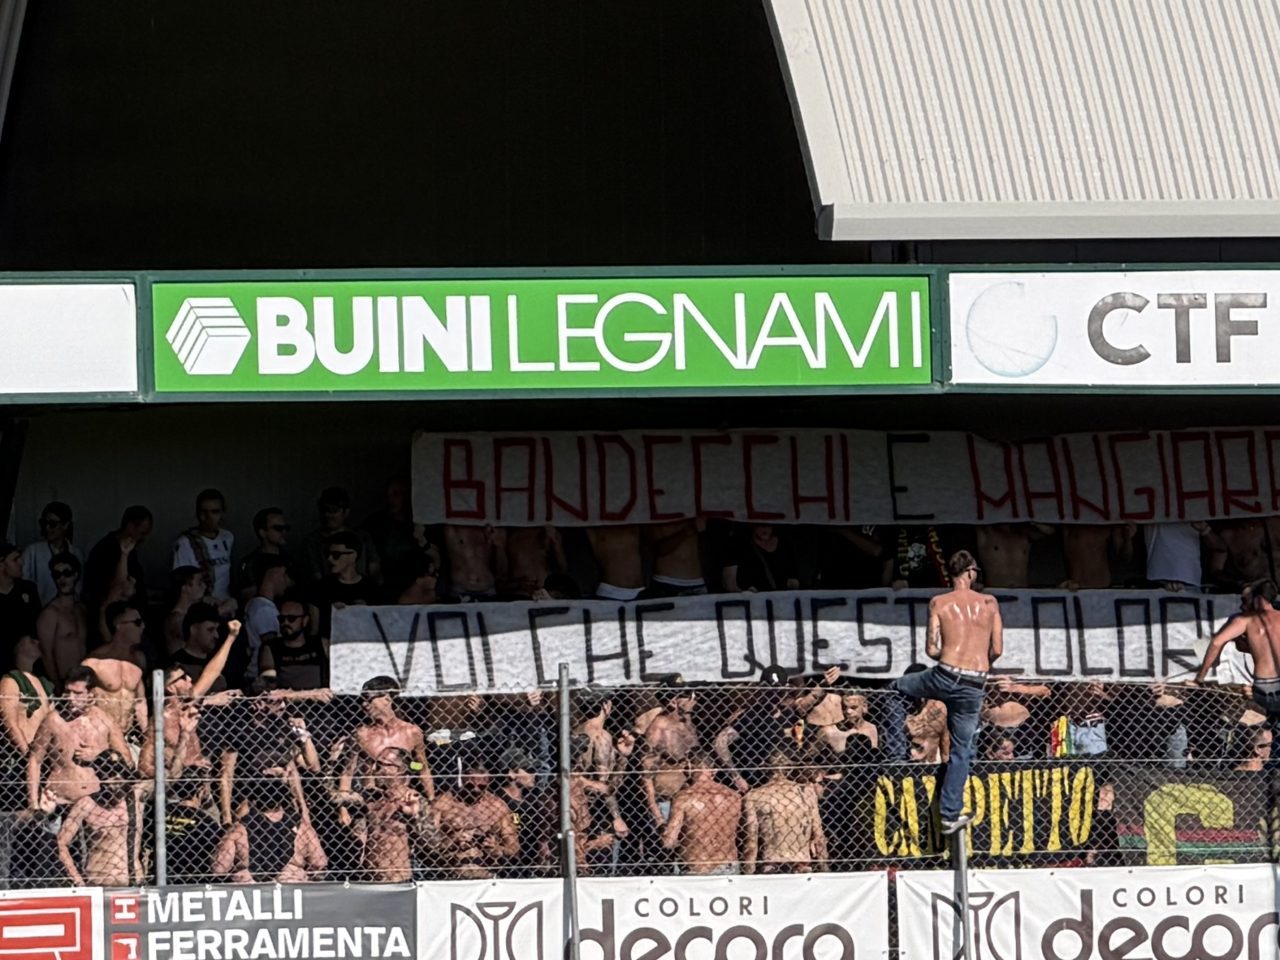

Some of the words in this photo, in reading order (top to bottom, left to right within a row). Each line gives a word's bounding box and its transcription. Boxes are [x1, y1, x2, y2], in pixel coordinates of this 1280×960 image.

[257, 295, 492, 375] BUINI
[507, 290, 922, 372] LEGNAMI
[1087, 292, 1267, 366] CTF
[443, 432, 850, 522] BANDECCHI
[888, 431, 935, 521] E
[372, 610, 494, 693] VOI
[530, 602, 676, 687] CHE
[716, 596, 934, 679] QUEST
[148, 889, 303, 923] METALLI
[634, 895, 768, 918] COLORI
[1113, 884, 1243, 908] COLORI
